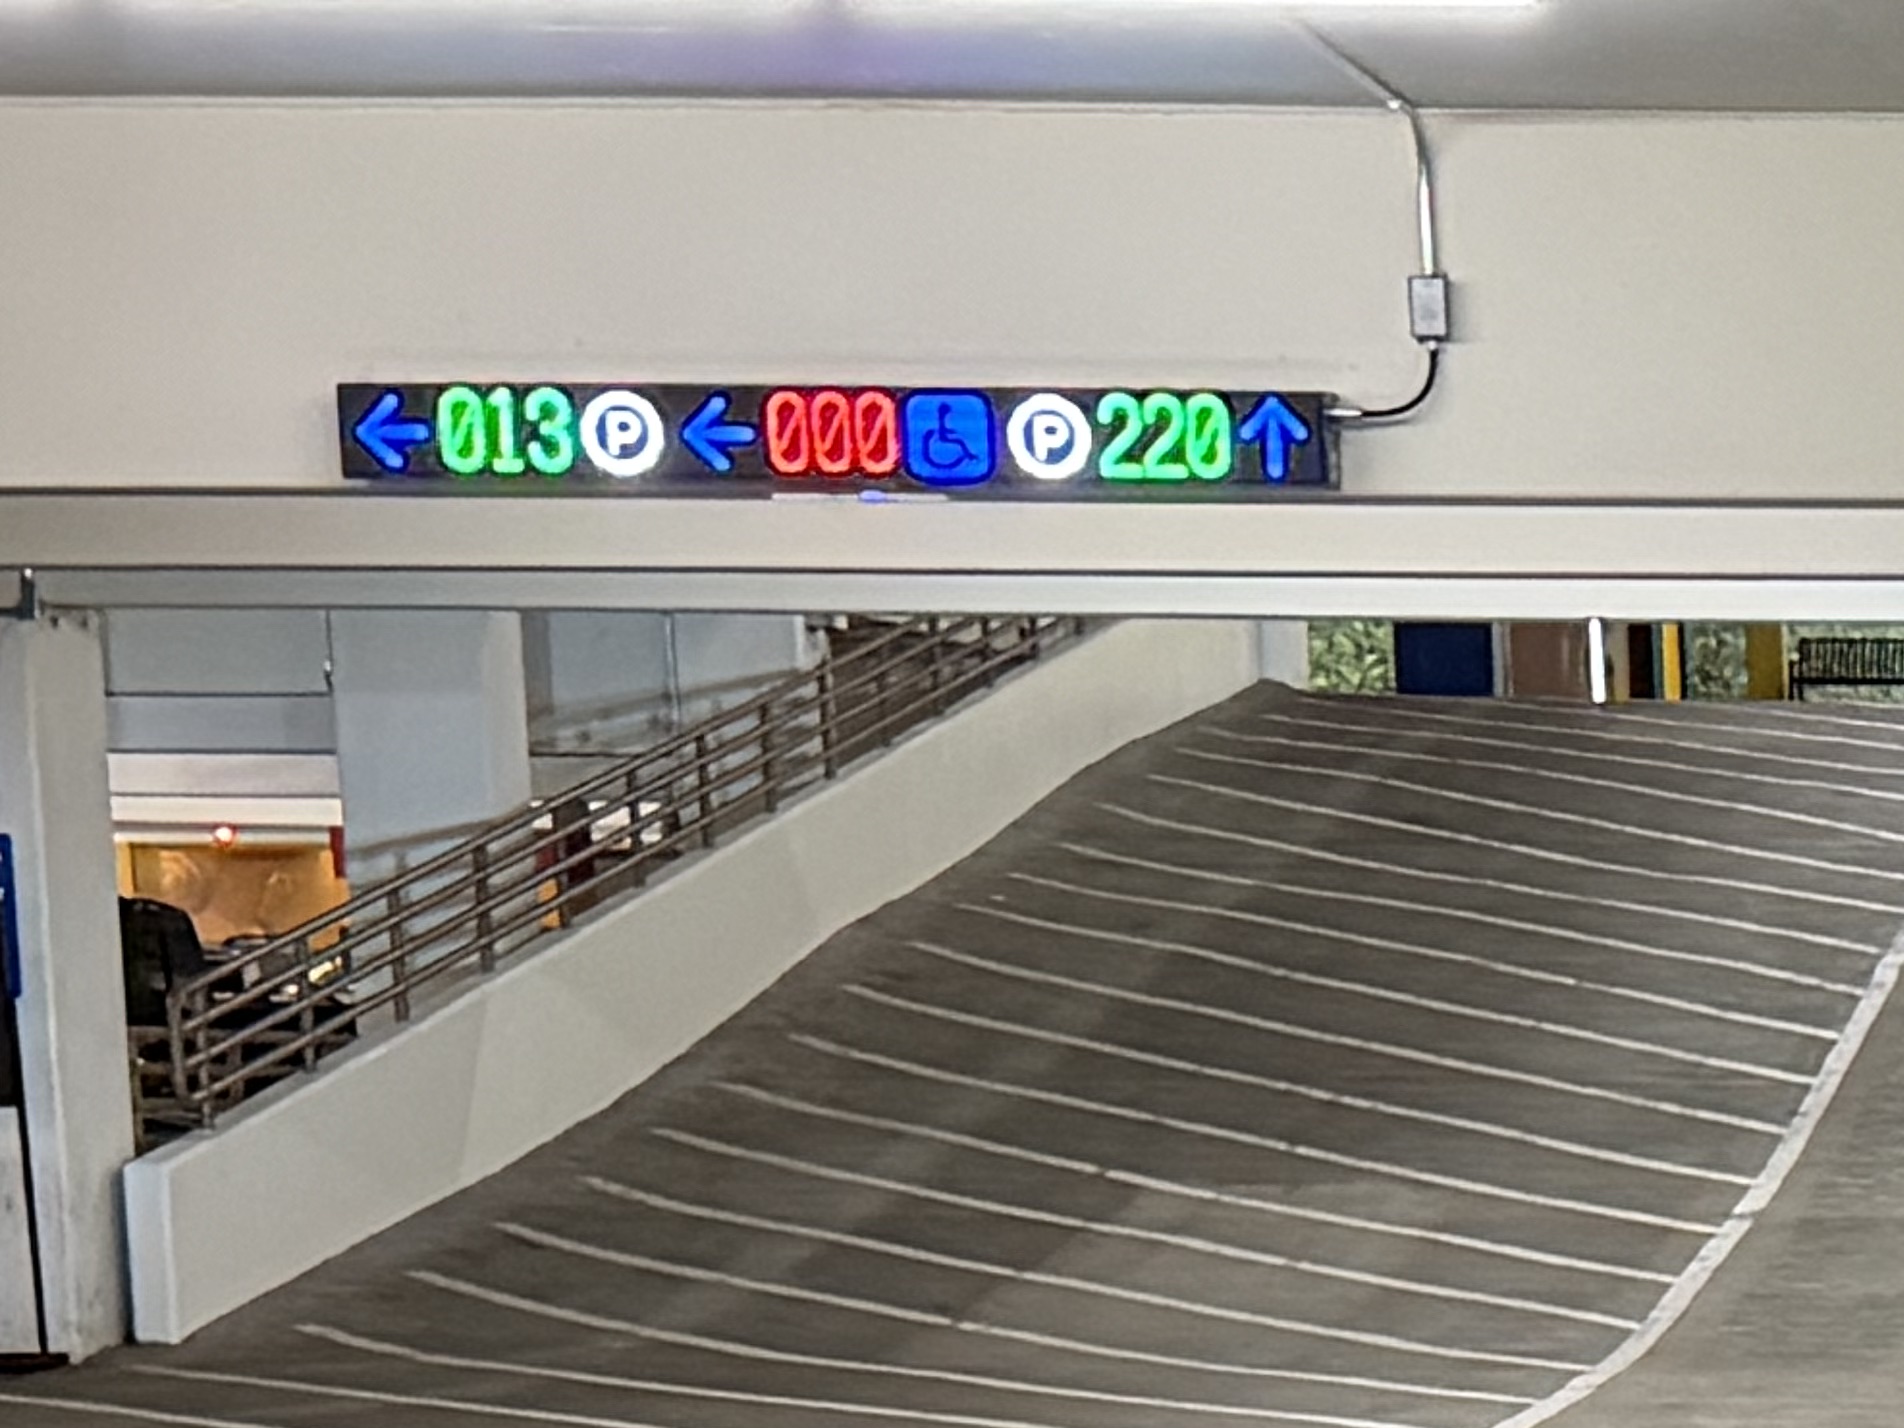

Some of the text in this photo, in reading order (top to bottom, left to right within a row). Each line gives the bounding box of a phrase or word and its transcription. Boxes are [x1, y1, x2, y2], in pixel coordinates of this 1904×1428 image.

[436, 385, 573, 475] 013
[765, 390, 900, 474] 000
[1097, 391, 1232, 480] 220
